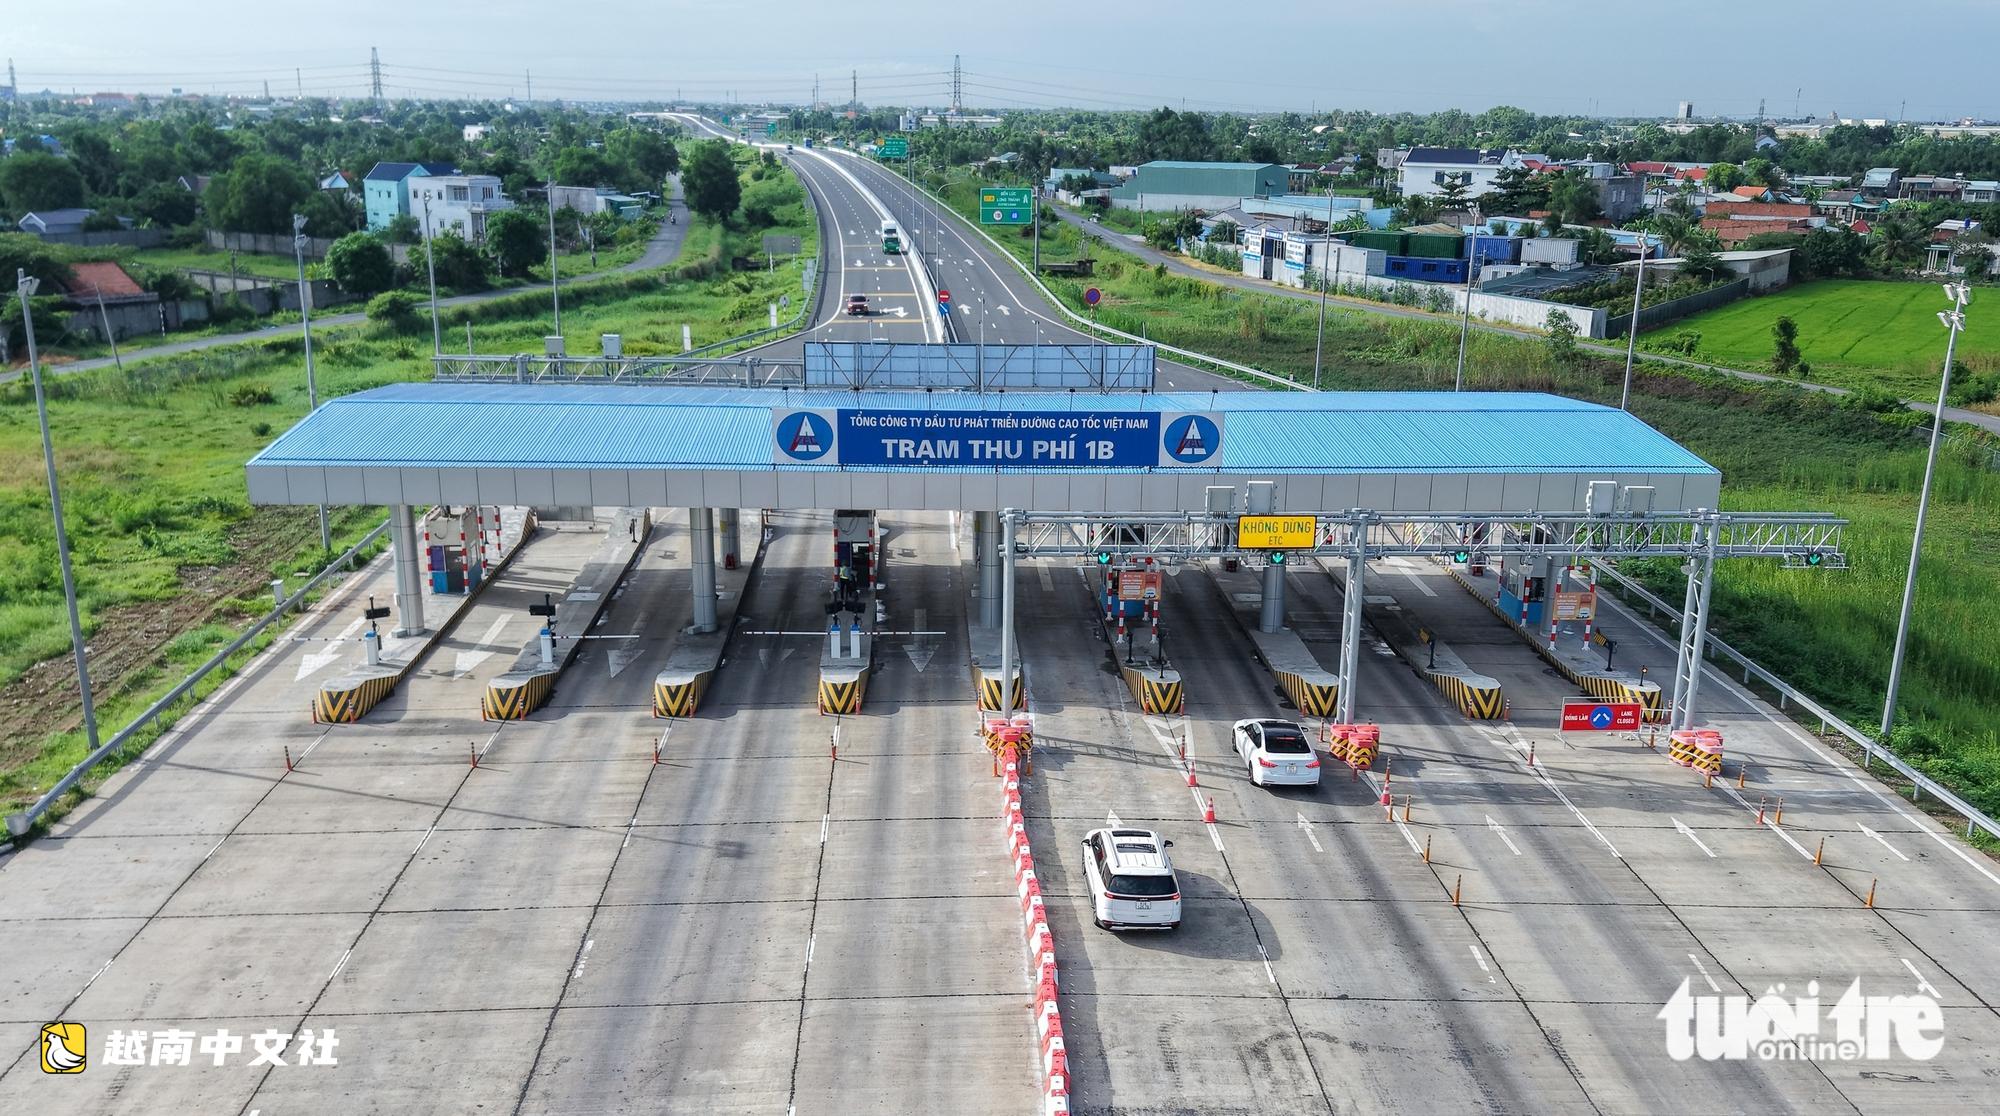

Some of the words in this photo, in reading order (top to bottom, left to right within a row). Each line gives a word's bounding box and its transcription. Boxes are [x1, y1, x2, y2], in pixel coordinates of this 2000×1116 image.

[850, 411, 877, 427] TỔNG
[879, 414, 907, 428] CÔNG
[909, 416, 922, 428] TY
[924, 413, 946, 428] ĐẦU
[948, 416, 963, 428] TƯ
[964, 414, 989, 429] PHÁT
[991, 412, 1019, 429] TRIỂN
[1020, 414, 1056, 429] ĐƯỜNG
[1058, 418, 1079, 429] CAO
[1081, 413, 1100, 429] TỐC
[1103, 416, 1125, 432] VIỆT
[1126, 418, 1149, 429] NAM
[881, 439, 959, 465] TRẠM
[967, 439, 1023, 460] THU
[1032, 433, 1077, 460] PHÍ
[1085, 440, 1115, 460] 1B
[1243, 519, 1279, 534] KHÔNG
[1283, 518, 1311, 534] DỪNG
[1268, 535, 1283, 545] ETC
[1578, 713, 1588, 721] LÀN
